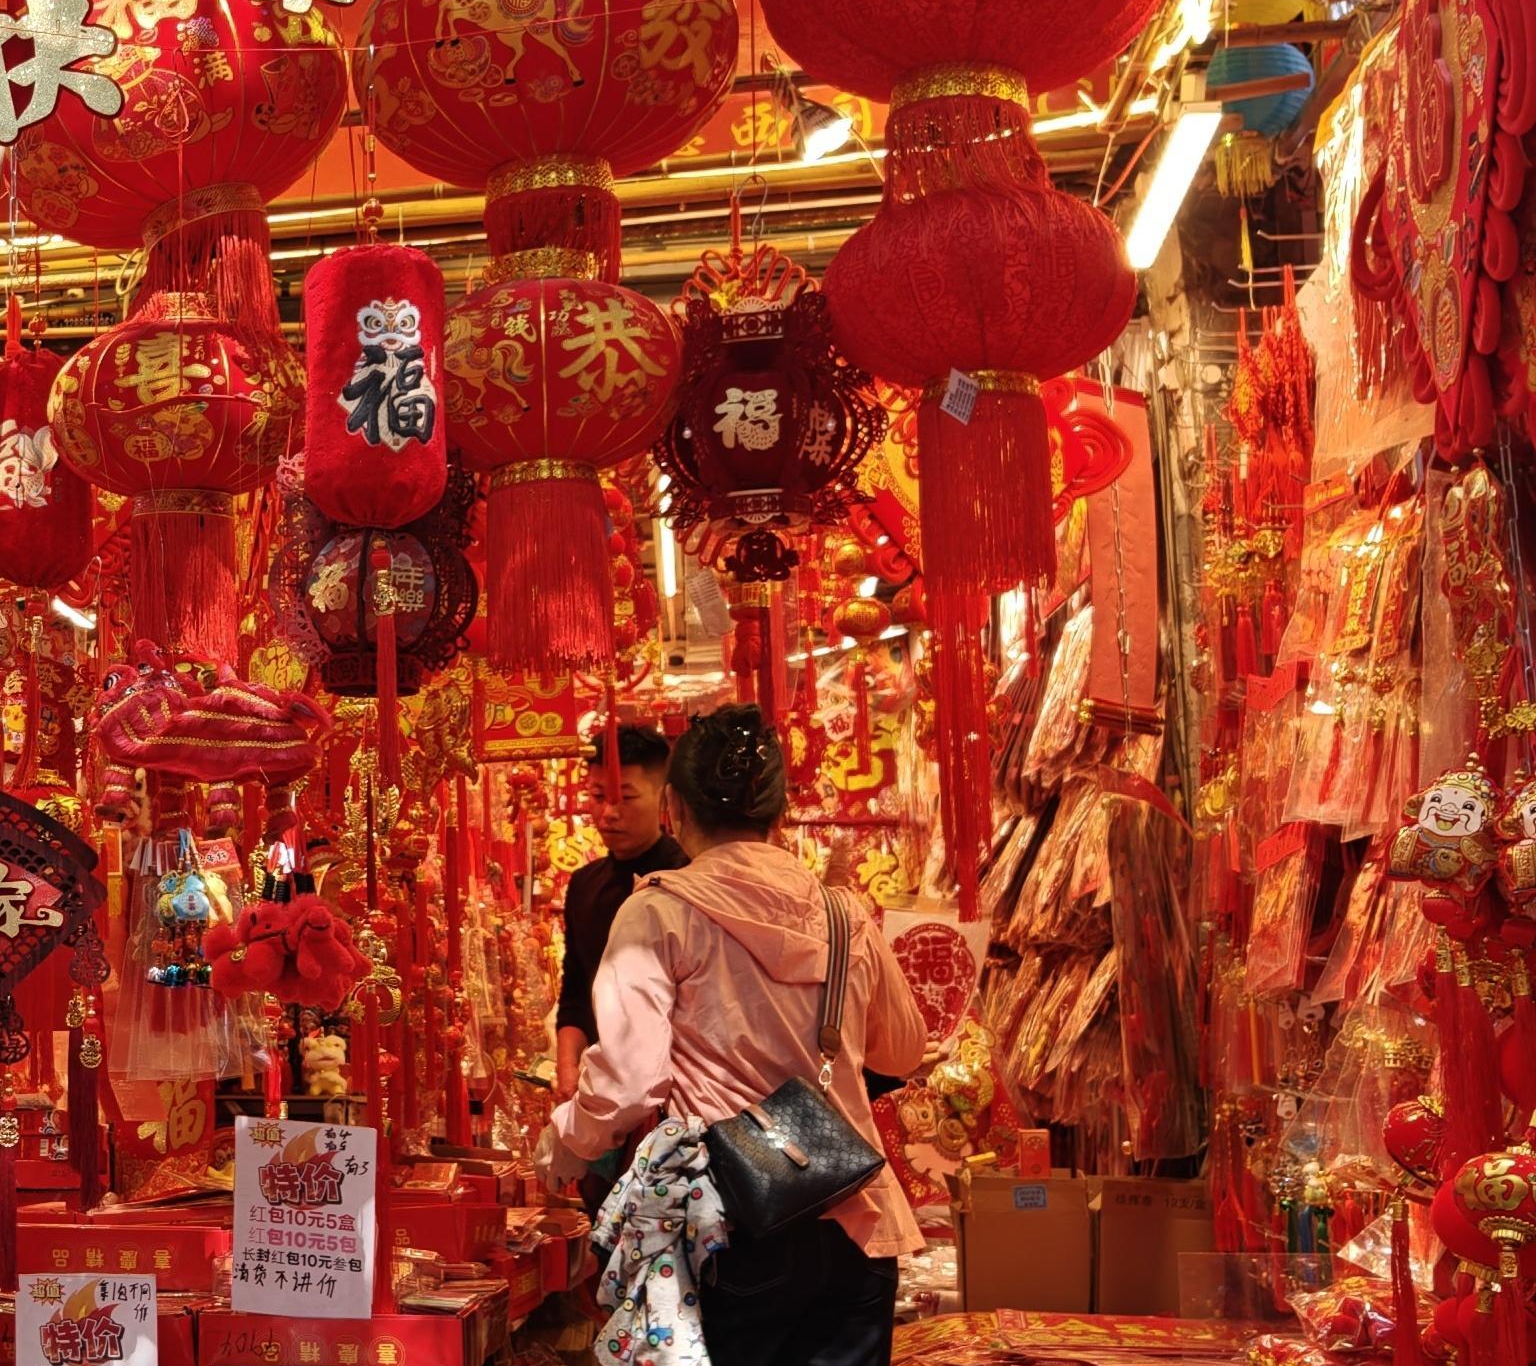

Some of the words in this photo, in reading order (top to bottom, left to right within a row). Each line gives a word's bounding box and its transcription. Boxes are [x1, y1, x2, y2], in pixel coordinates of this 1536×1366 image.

[113, 331, 212, 405] 喜
[558, 297, 668, 404] 恭
[341, 342, 438, 446] 福
[712, 387, 784, 452] 福
[259, 1161, 345, 1206] 特价
[247, 1226, 358, 1254] 红包10元5包
[248, 1204, 357, 1233] 红包10元5盒
[241, 1246, 363, 1273] 长封红包10元叁包
[39, 1315, 125, 1366] 特价
